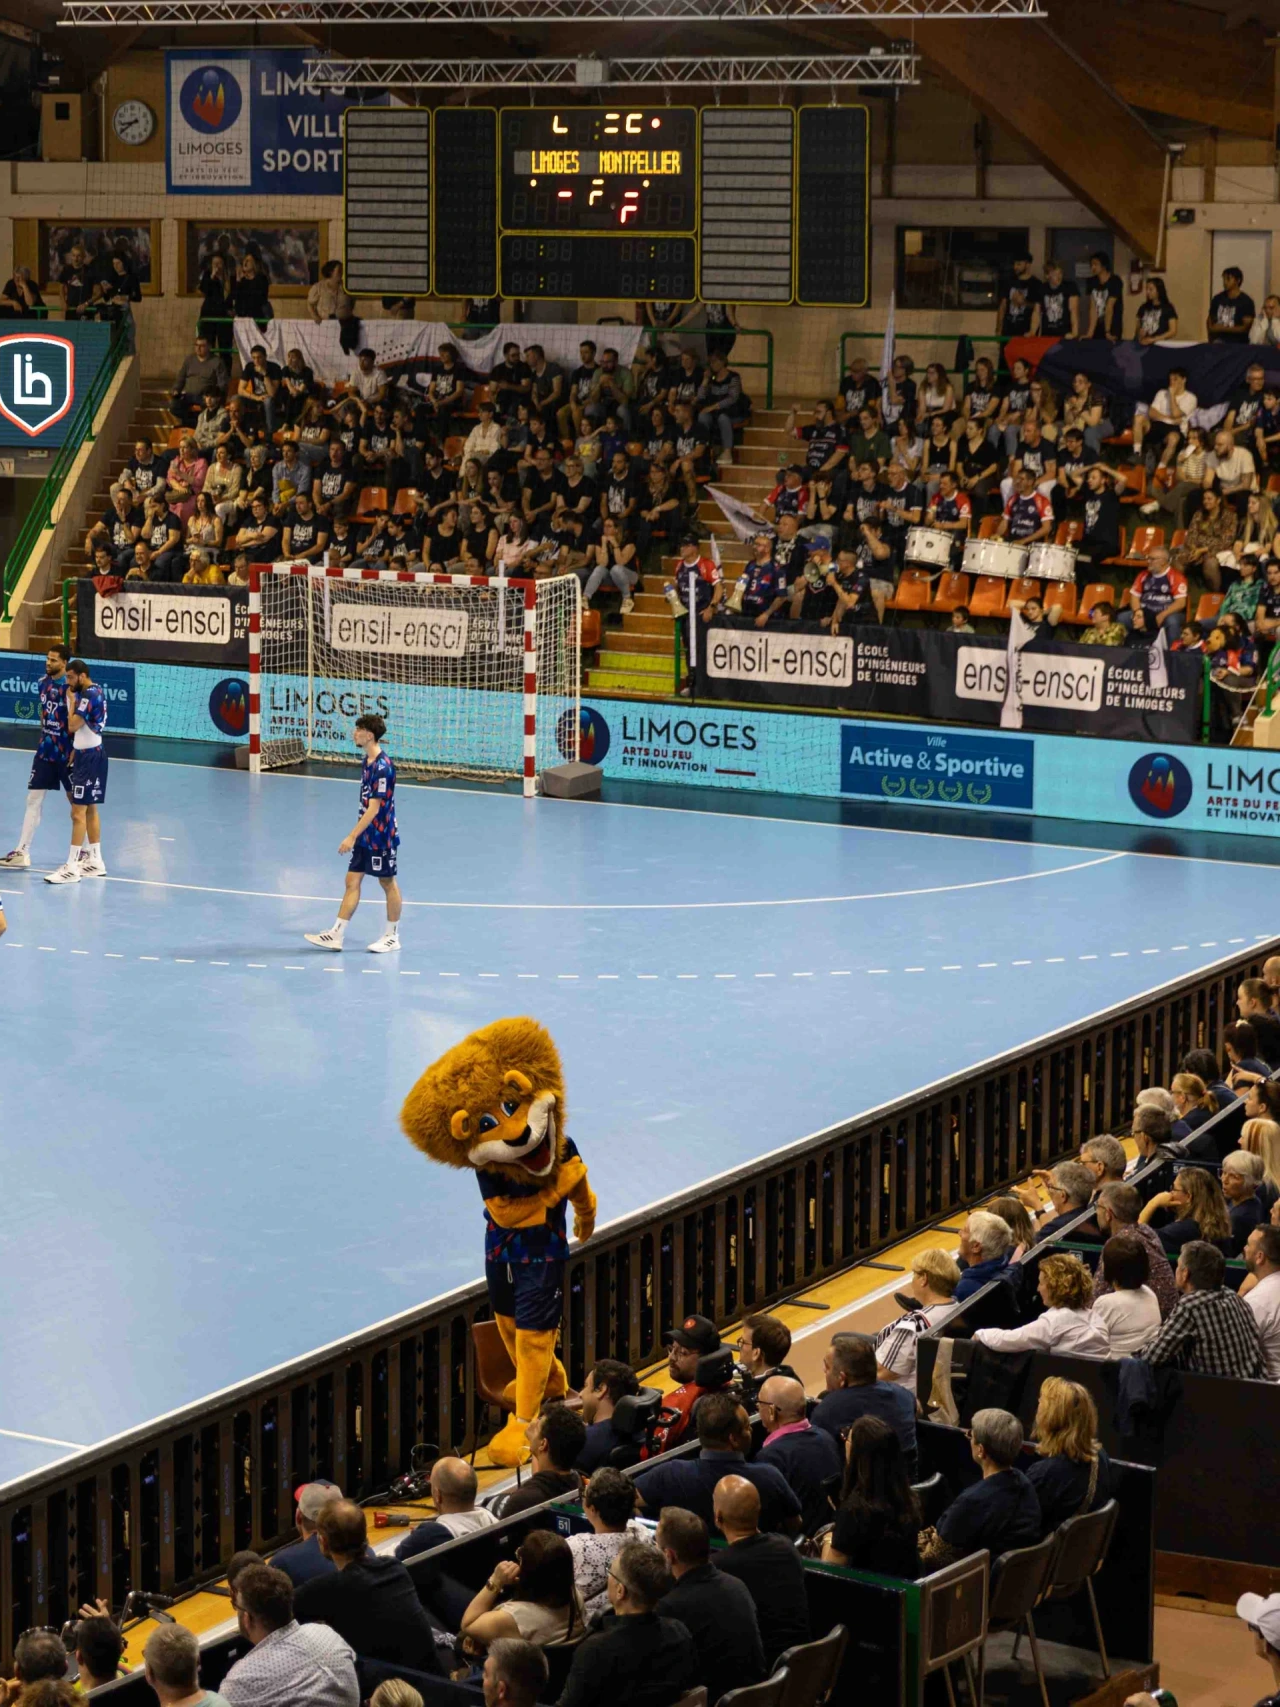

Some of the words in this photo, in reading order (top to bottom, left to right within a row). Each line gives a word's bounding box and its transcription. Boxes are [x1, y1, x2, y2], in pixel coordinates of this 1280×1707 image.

[178, 142, 243, 155] LIMOGES
[531, 151, 580, 174] LIMOGES
[599, 151, 681, 175] MONTPELLIER
[100, 600, 225, 636] ensil-ensci
[234, 628, 246, 639] DE
[338, 612, 462, 650] ensil-ensci
[713, 637, 849, 678] ensil-ensci
[857, 643, 889, 657] ÉCOLE
[857, 658, 927, 674] D'INGÉNIEURS
[1107, 665, 1144, 682] ÉCOLE
[857, 671, 872, 682] DE
[875, 671, 918, 686] LIMOGES
[963, 662, 1098, 702] ens-ensci
[46, 700, 59, 714] 97
[269, 686, 390, 719] LIMOGES
[1106, 694, 1121, 707] DE
[1125, 697, 1174, 712] LIMOGES
[622, 716, 757, 751] LIMOGES
[926, 736, 947, 748] Ville
[623, 746, 649, 757] ARTS
[653, 748, 668, 758] DU
[672, 750, 692, 760] FEU
[622, 757, 635, 766] ET
[638, 758, 708, 772] INNOVATION
[849, 746, 914, 769] Active
[917, 751, 931, 771] &
[935, 753, 1025, 778] Sportive
[1207, 796, 1238, 807] ARTS
[1243, 799, 1260, 809] DU
[1206, 808, 1221, 817] ET
[558, 1520, 568, 1530] 51
